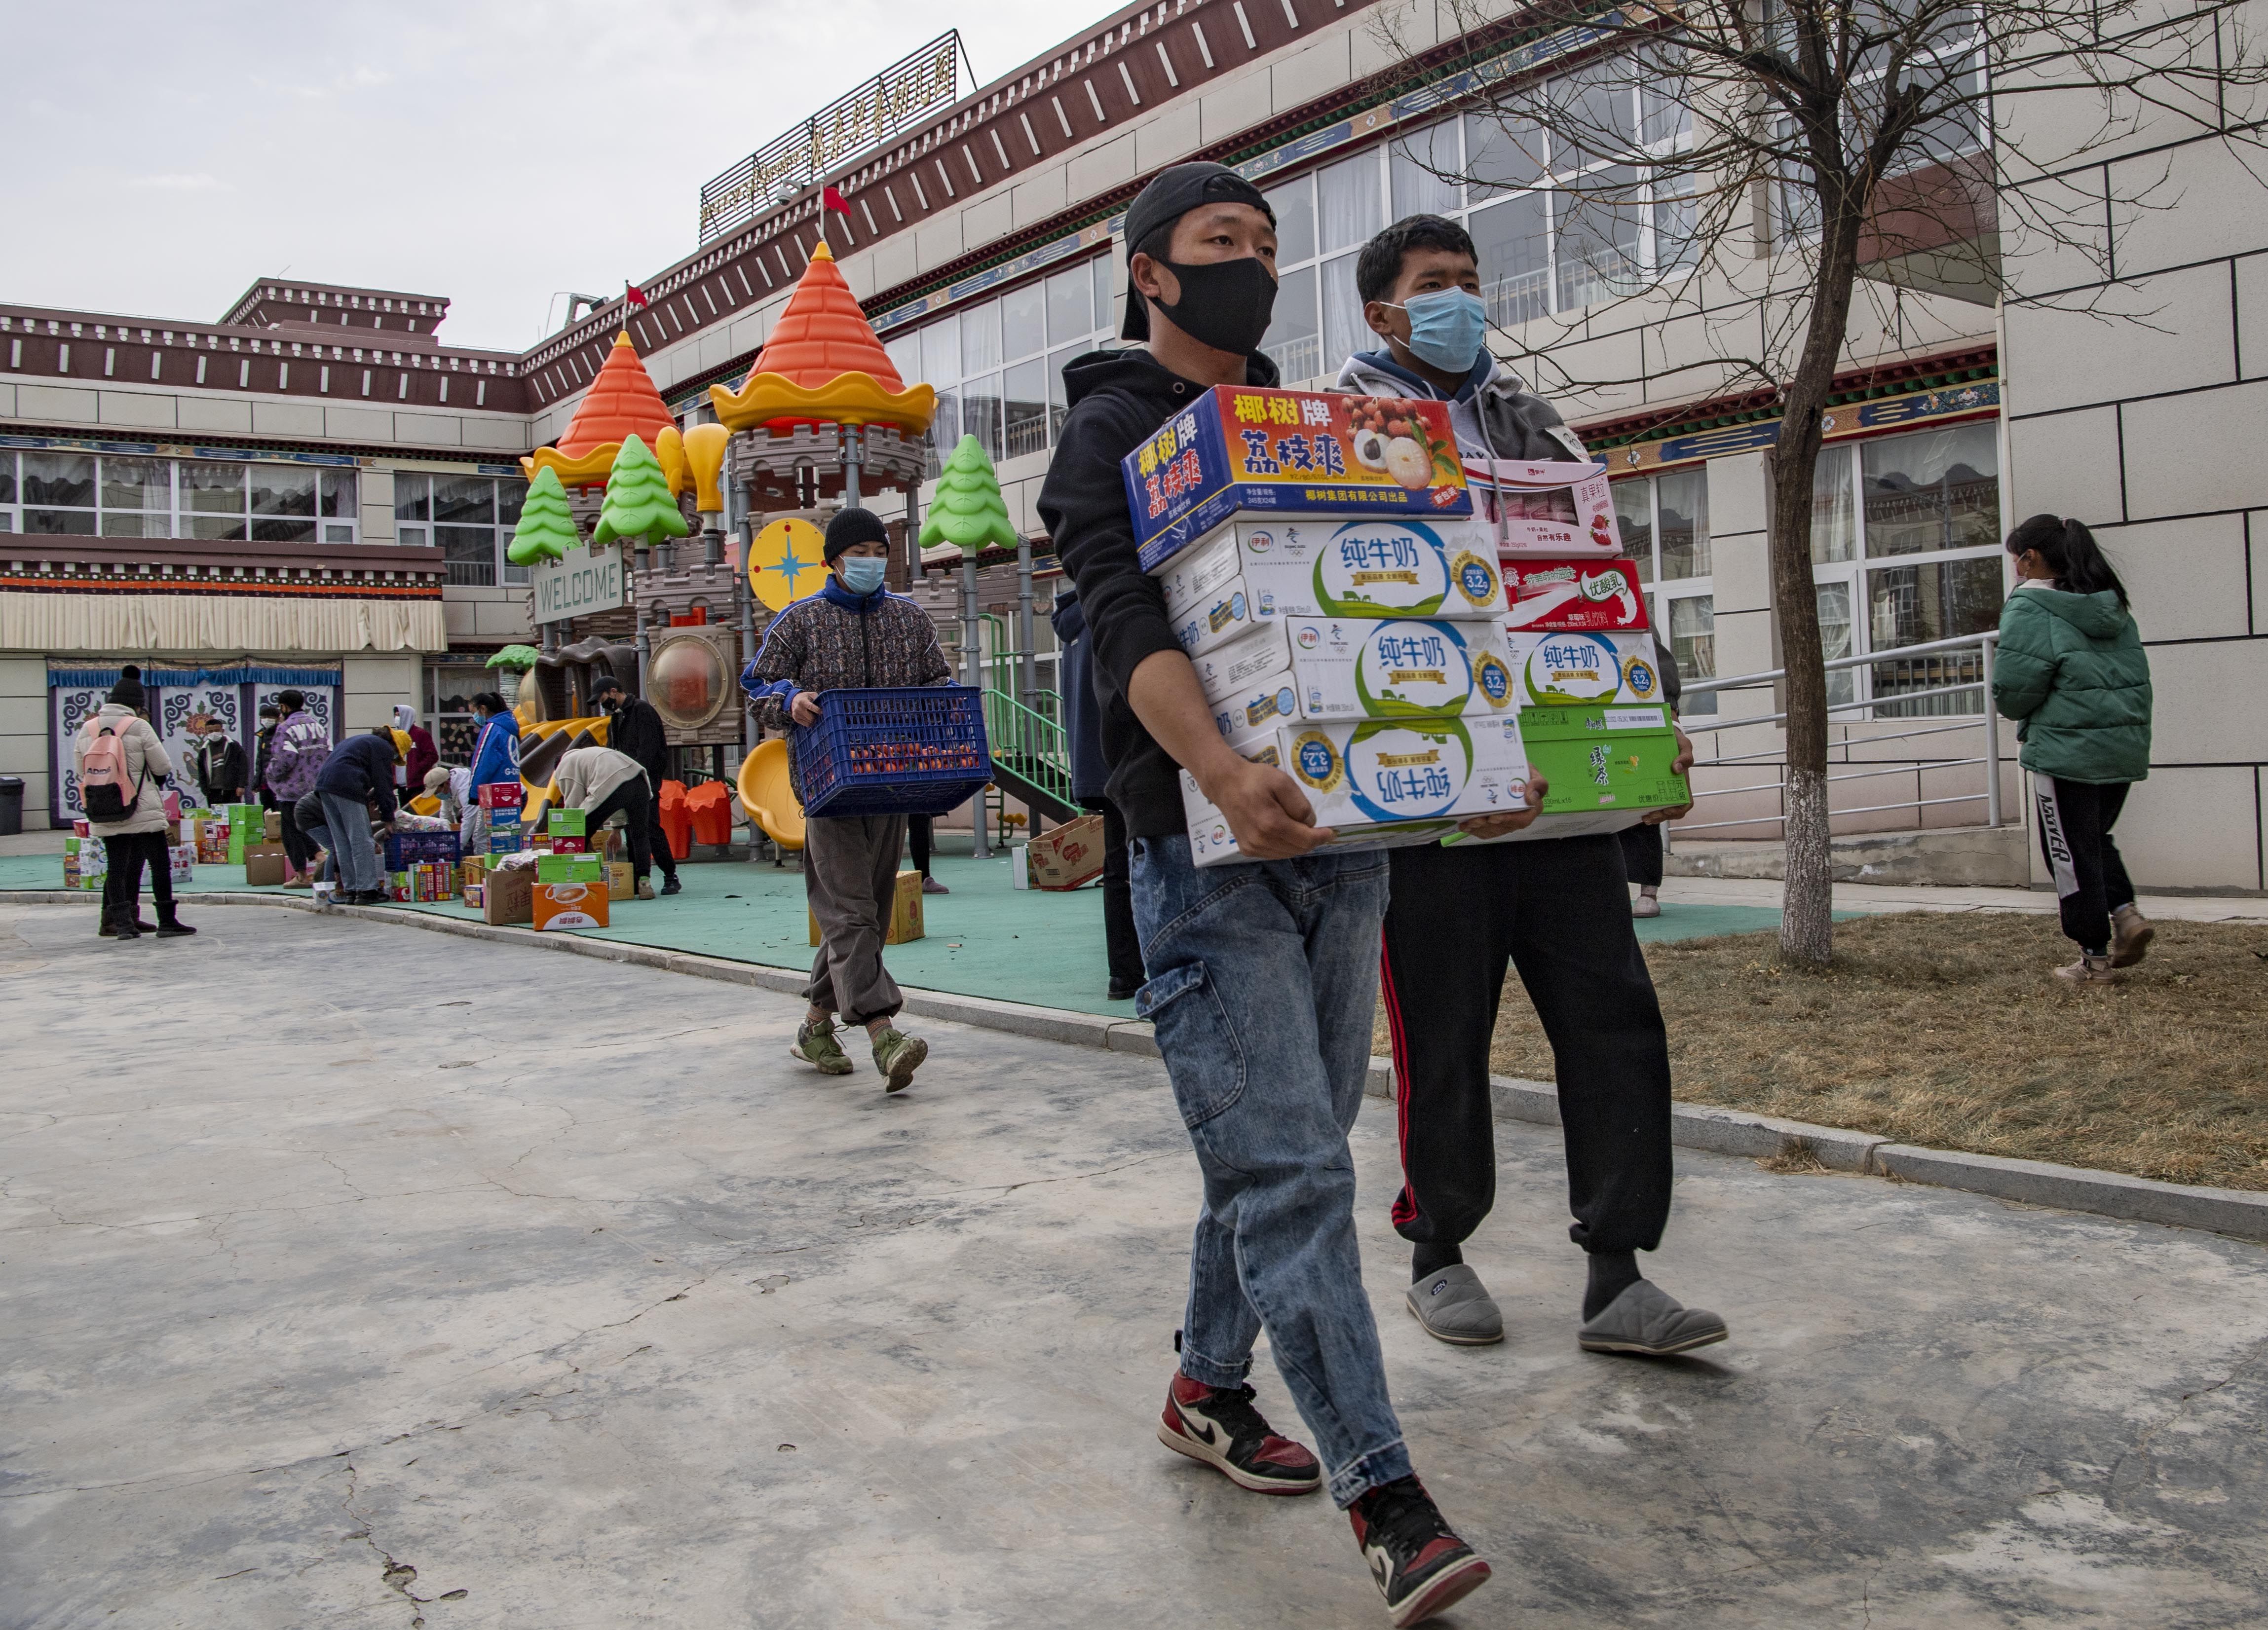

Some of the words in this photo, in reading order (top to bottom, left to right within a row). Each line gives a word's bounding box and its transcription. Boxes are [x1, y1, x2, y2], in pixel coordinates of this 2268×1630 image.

[1233, 394, 1333, 427] 椰树牌
[1138, 413, 1198, 479] 椰树牌
[1240, 429, 1347, 477] 荔枝爽
[1145, 448, 1203, 519] 荔枝爽
[1434, 486, 1457, 504] 新包装
[1580, 481, 1606, 504] 真果粒
[1305, 489, 1408, 503] 椰树集团有限公司出品
[1251, 537, 1270, 547] 伊利
[1537, 533, 1572, 542] 自然有乐趣
[1341, 537, 1420, 568] 纯牛奶
[539, 563, 617, 613] WELCOME
[1466, 575, 1488, 589] 3.2g
[1589, 573, 1622, 596] 优酸乳
[1585, 611, 1608, 627] 乳饮料
[1177, 621, 1200, 648] 牛奶
[1378, 636, 1446, 667] 纯牛奶
[1544, 645, 1599, 669] 纯牛奶
[1485, 676, 1505, 690] 3.2g
[1633, 675, 1649, 685] 3.2g
[1303, 751, 1328, 767] 3.2g
[1589, 745, 1609, 785] 绿茶
[1376, 767, 1450, 803] 纯牛奶
[1638, 794, 1659, 803] 优惠价
